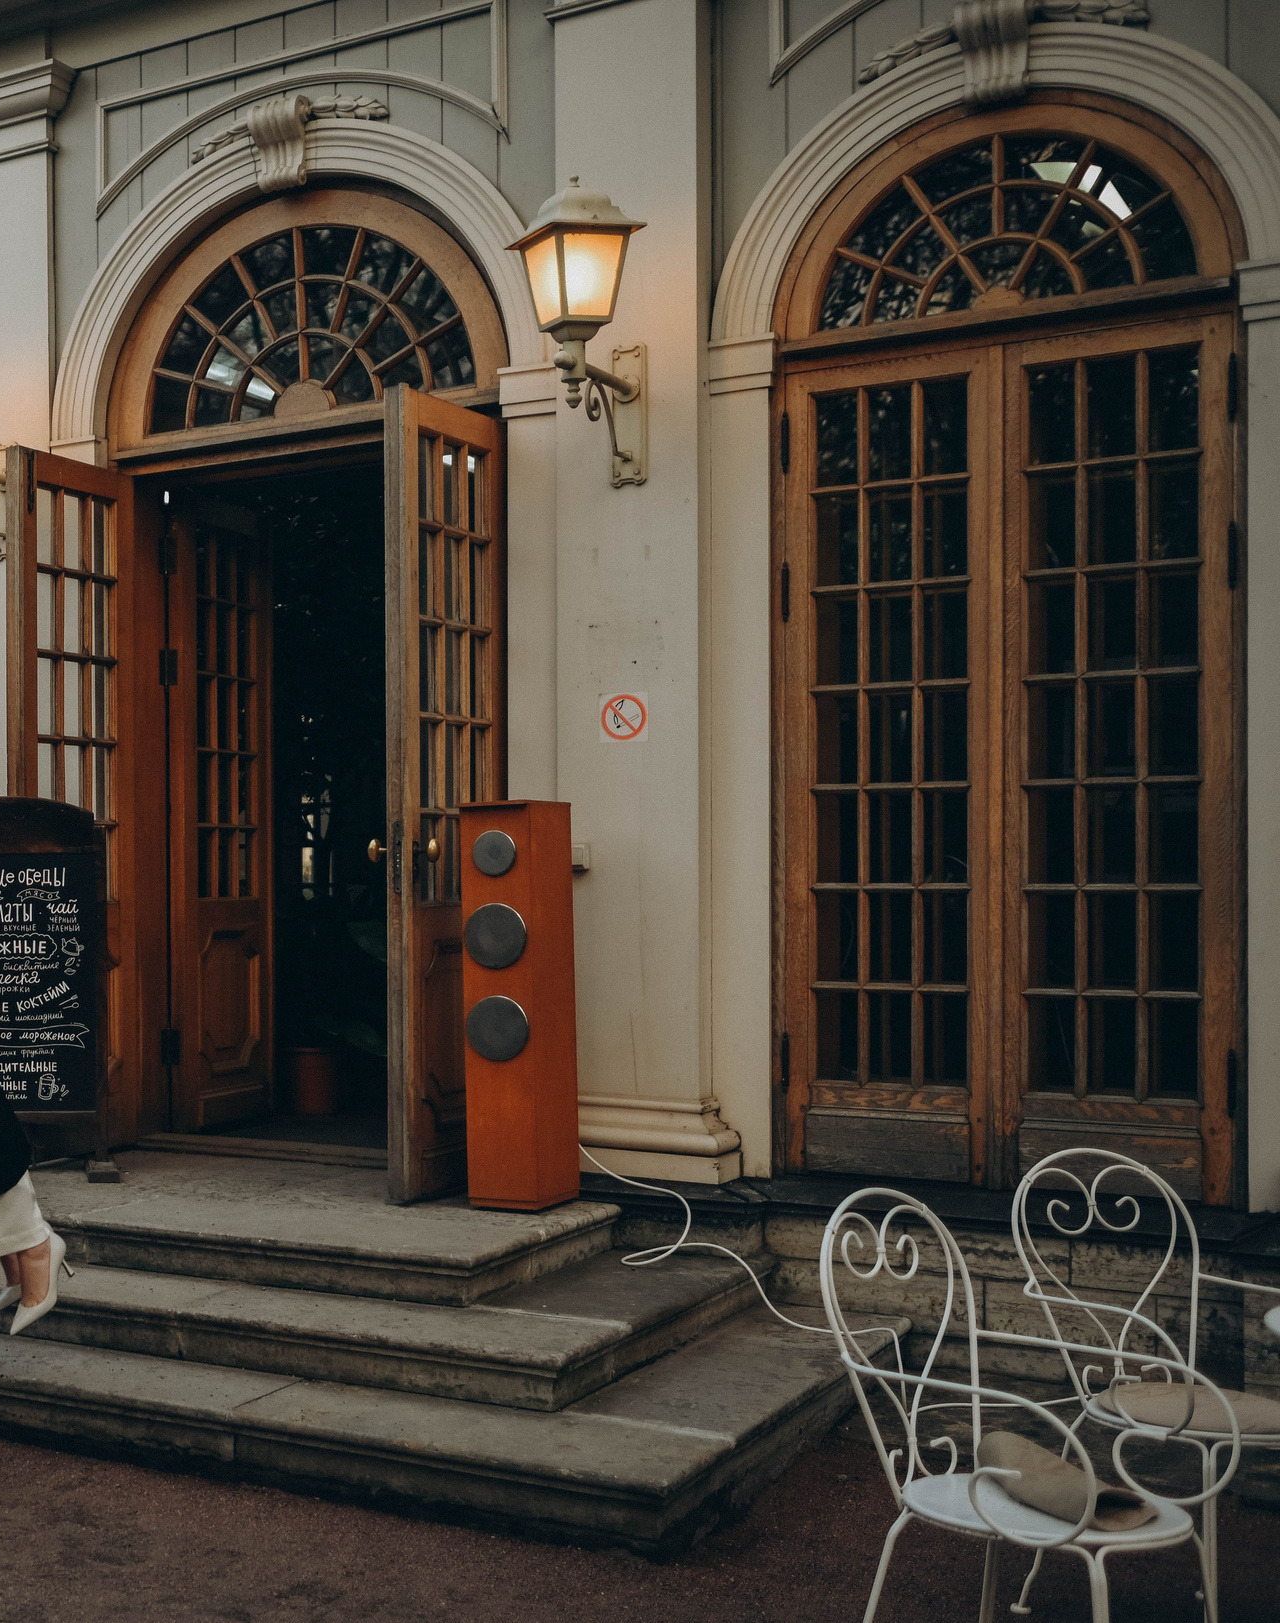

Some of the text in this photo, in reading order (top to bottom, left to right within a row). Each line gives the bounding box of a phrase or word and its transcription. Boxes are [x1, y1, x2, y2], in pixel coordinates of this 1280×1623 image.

[25, 890, 53, 900] МЯСО
[46, 899, 79, 914] чай
[49, 915, 77, 924] ЧЁРНЫЙ
[4, 923, 37, 932] ВКУСНЫЕ
[3, 960, 60, 972] бисквитные
[17, 980, 70, 1013] КОКТЕЙЛИ
[15, 1011, 64, 1024] шоколадный
[19, 1031, 76, 1043] мороженое
[21, 1048, 55, 1058] фруктах
[0, 1081, 27, 1091] ЧНЫЕ
